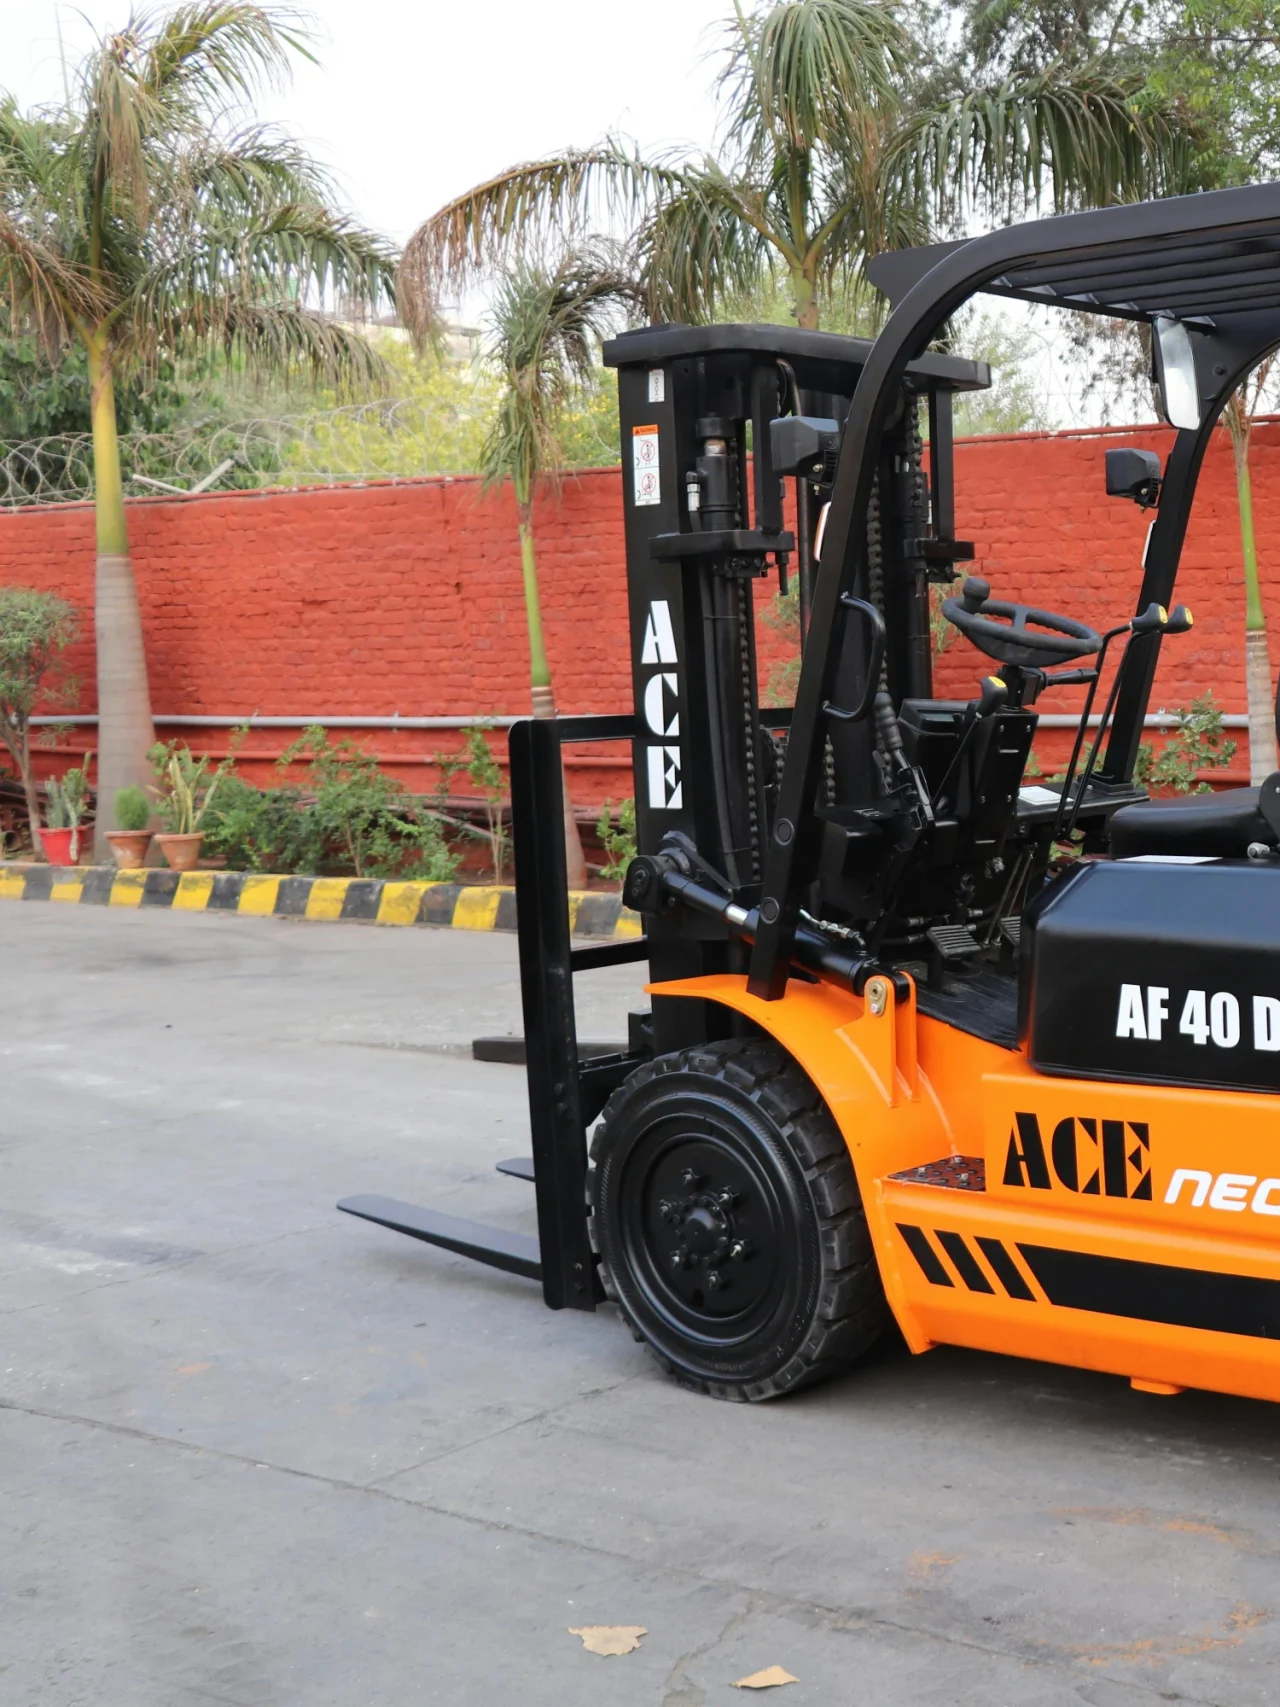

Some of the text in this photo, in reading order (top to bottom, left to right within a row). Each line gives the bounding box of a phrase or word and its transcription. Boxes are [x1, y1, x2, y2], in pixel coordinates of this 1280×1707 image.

[641, 599, 683, 810] ACE
[1115, 983, 1169, 1041] AF
[1178, 989, 1241, 1049] 40
[1002, 1111, 1153, 1201] ACE
